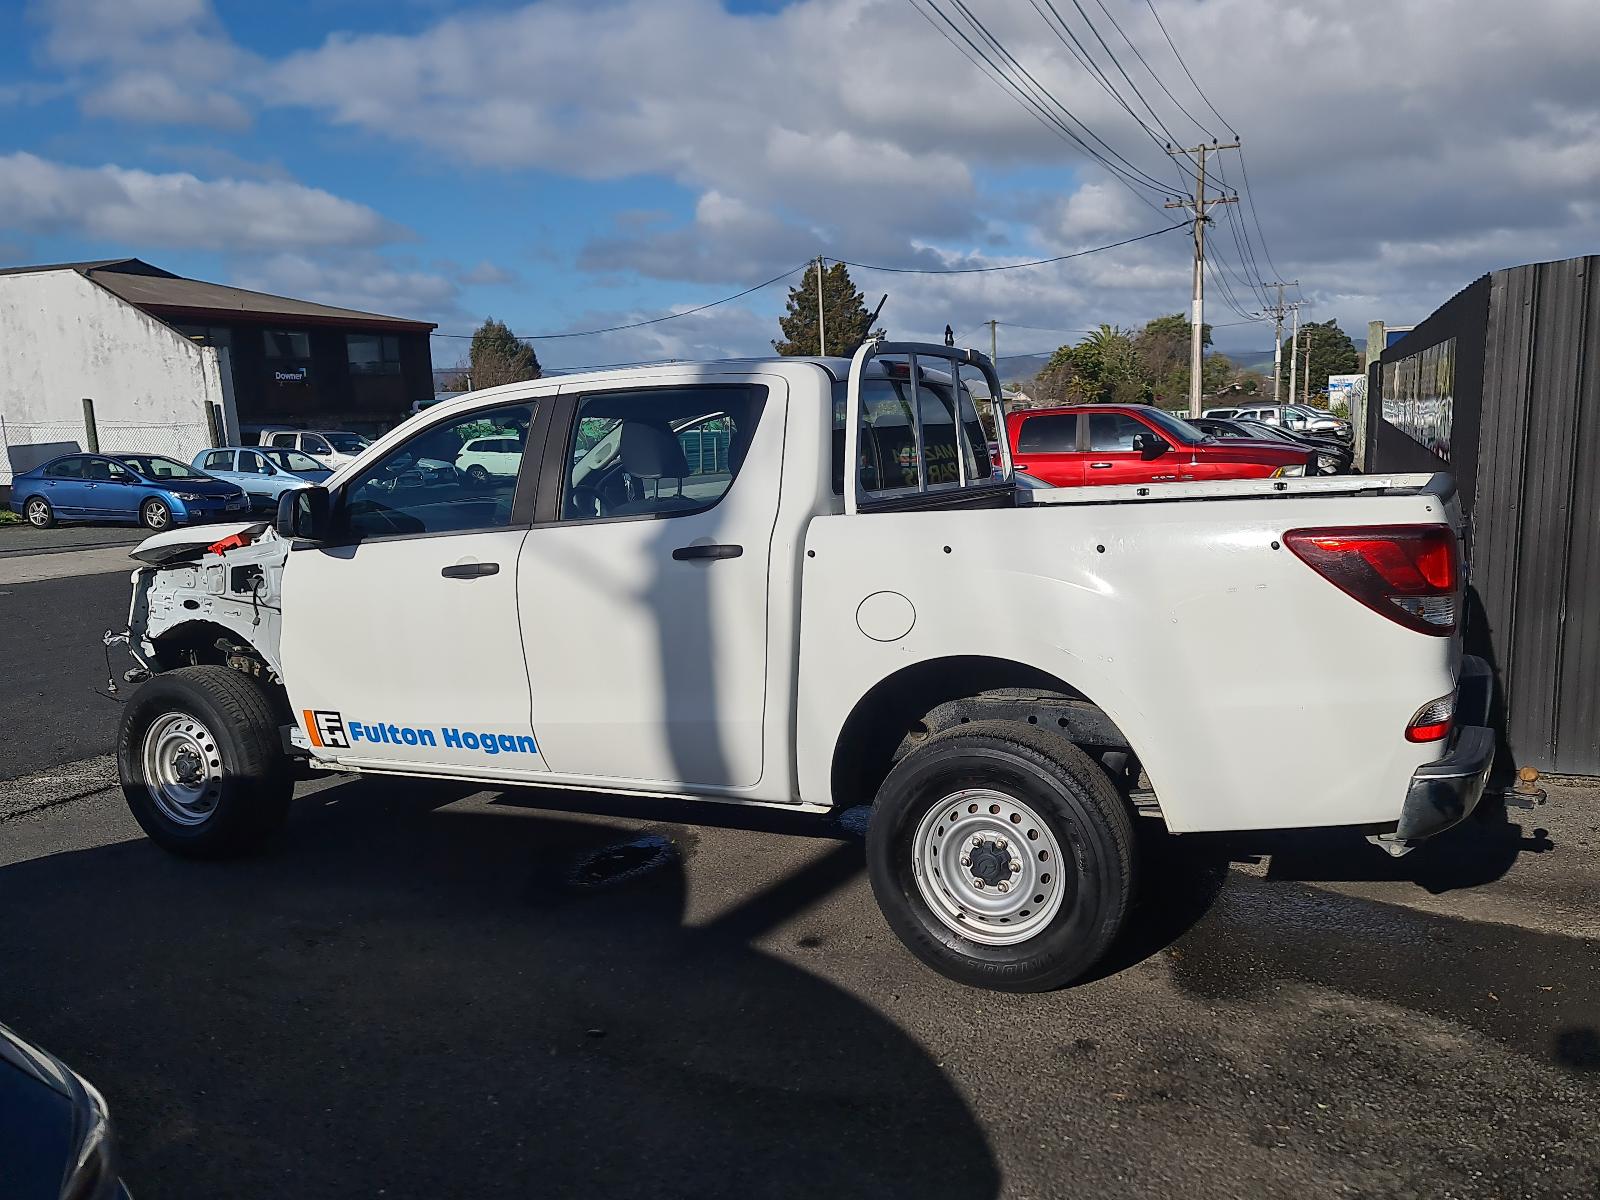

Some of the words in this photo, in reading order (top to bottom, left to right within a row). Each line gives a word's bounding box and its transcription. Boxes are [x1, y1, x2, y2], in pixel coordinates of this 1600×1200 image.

[275, 371, 303, 380] Downer
[348, 721, 437, 747] Fulton
[442, 727, 538, 755] Hogan
